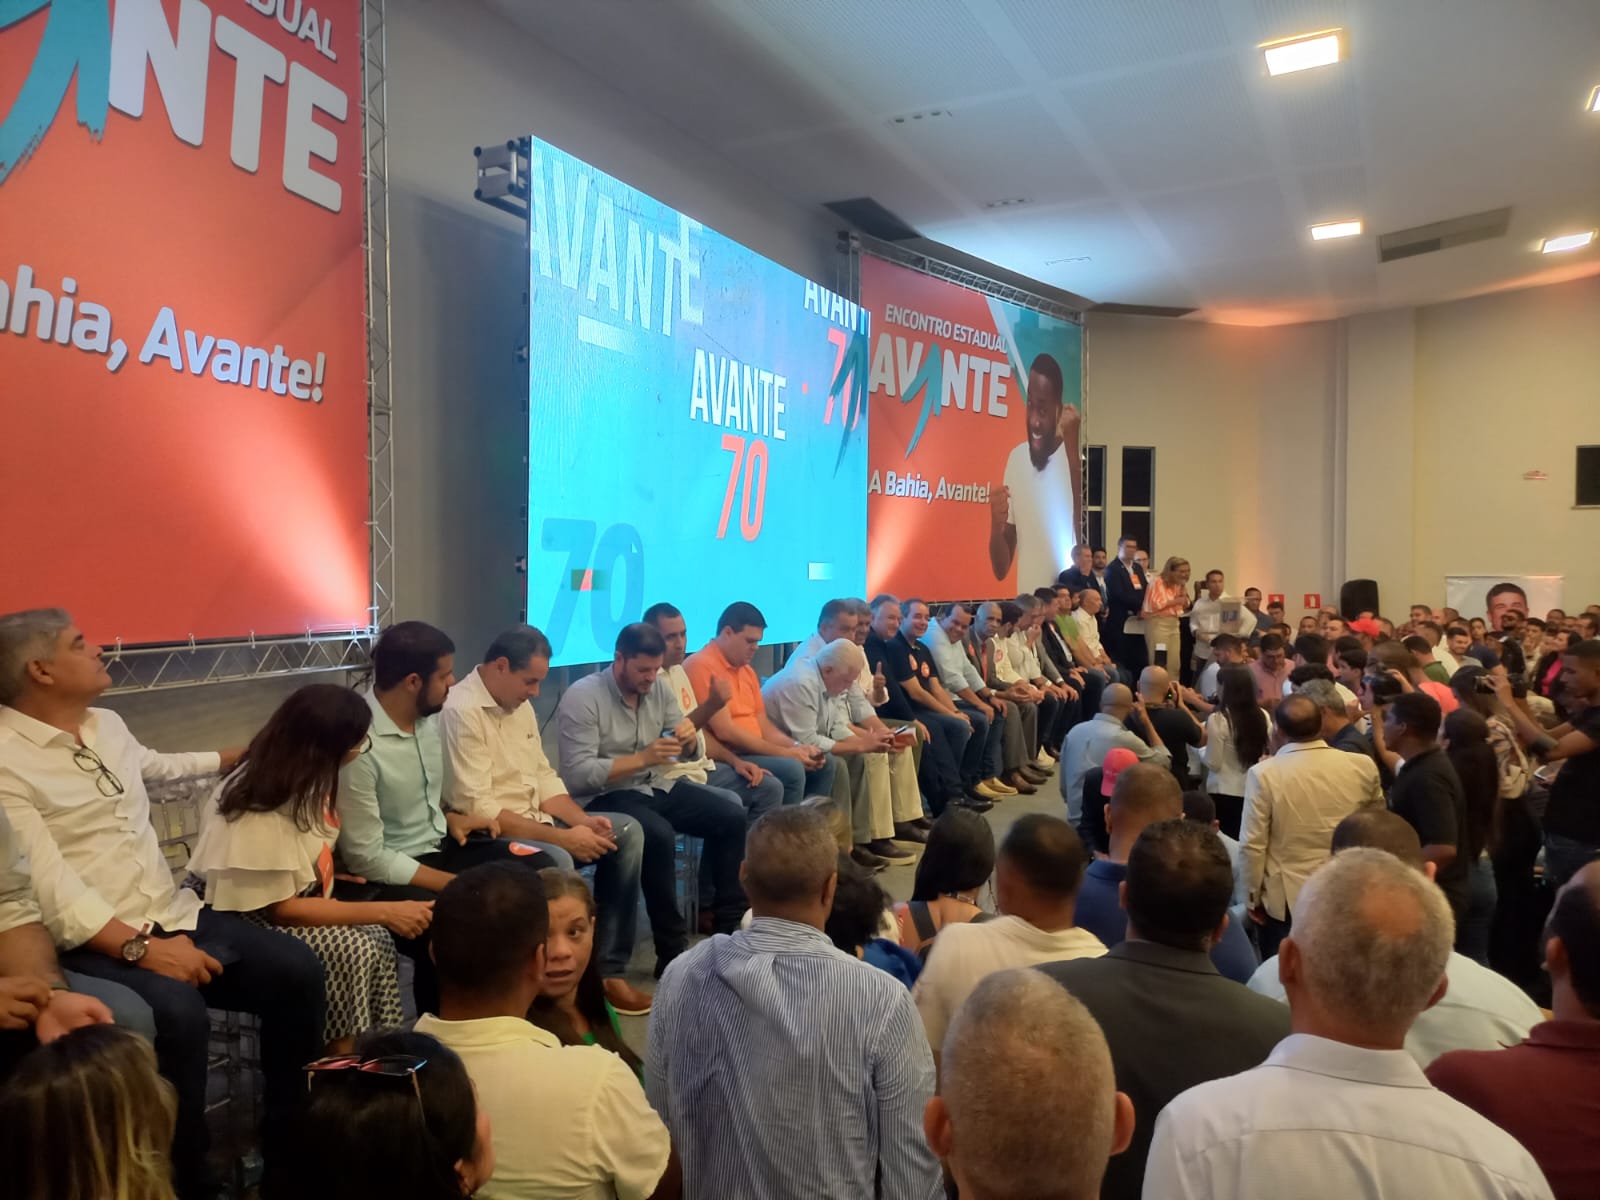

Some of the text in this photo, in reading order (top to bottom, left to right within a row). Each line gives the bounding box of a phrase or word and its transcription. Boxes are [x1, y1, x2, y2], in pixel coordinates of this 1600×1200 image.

[0, 264, 325, 402] hia, Avante!
[885, 303, 1008, 354] ENCONTRO ESTADUAL
[690, 348, 787, 440] AVANTE
[869, 332, 1012, 418] AVANTE
[716, 433, 769, 541] 70
[868, 469, 991, 504] A Bahia, Avante!
[541, 517, 645, 657] 70
